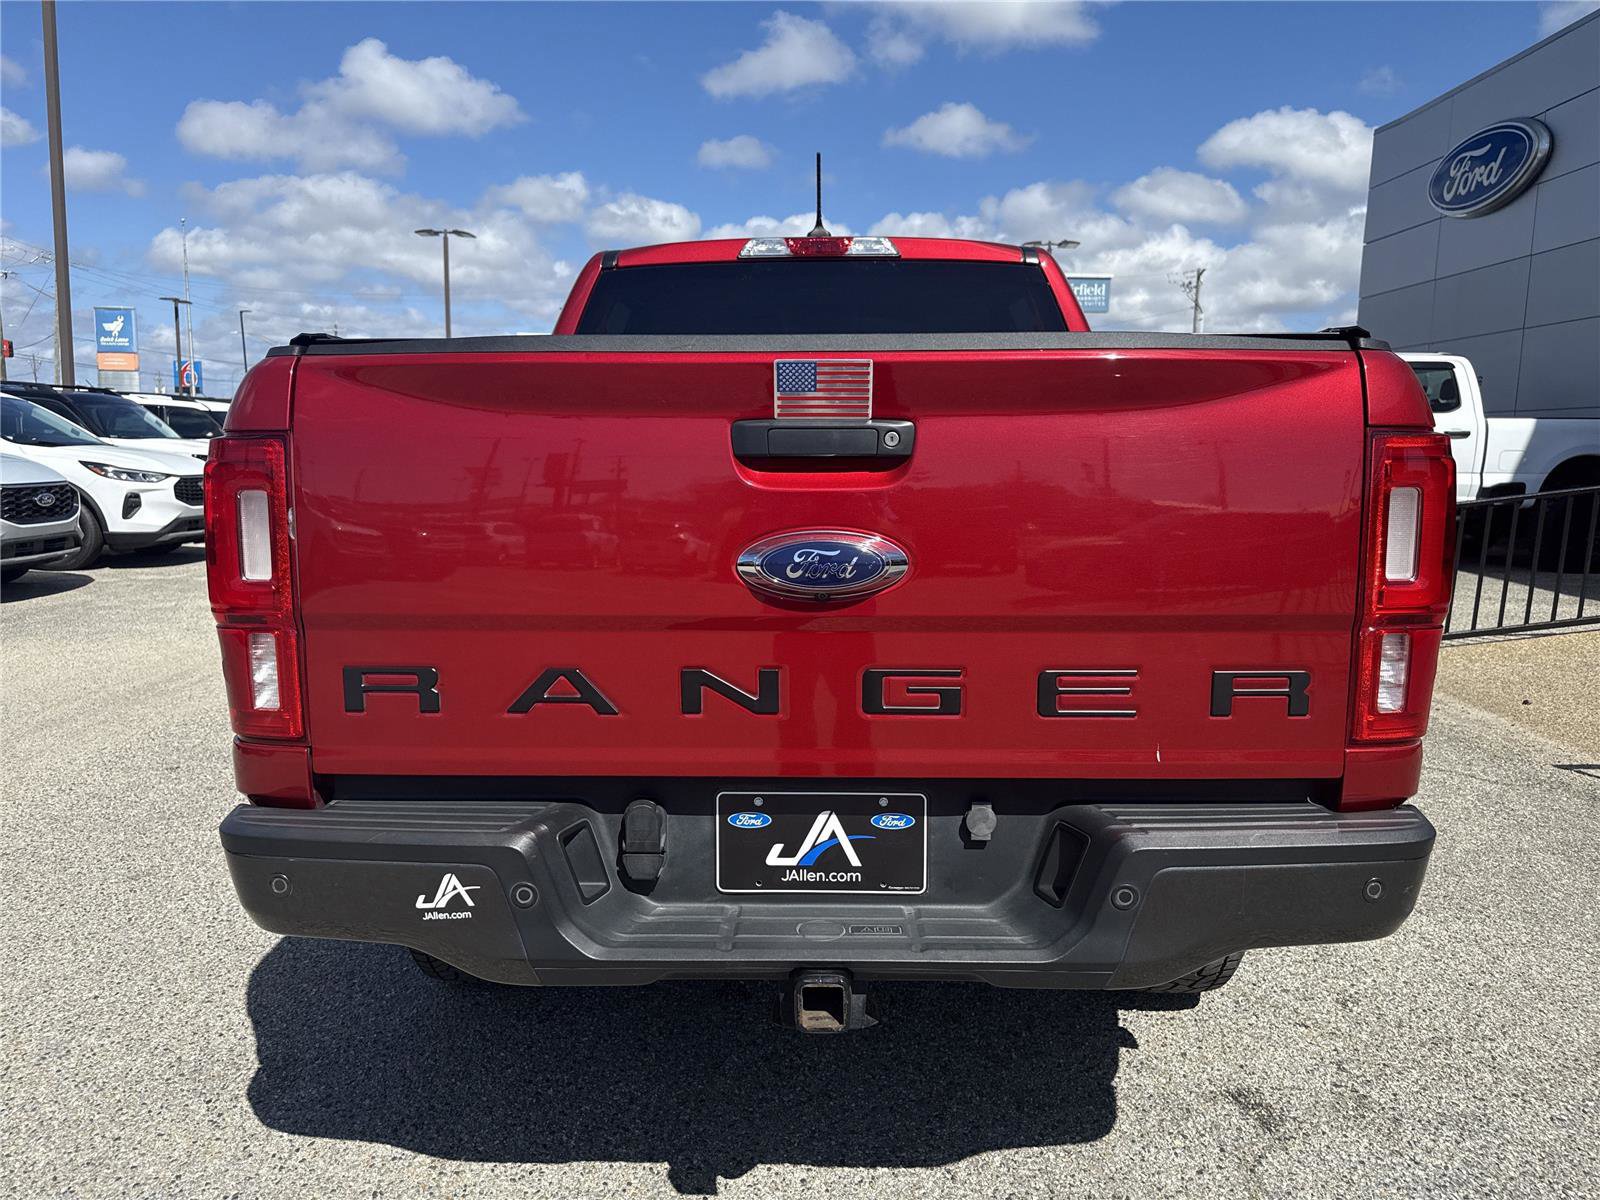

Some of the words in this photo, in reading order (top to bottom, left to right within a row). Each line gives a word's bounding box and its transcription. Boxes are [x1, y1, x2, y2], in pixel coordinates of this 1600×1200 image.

[1443, 143, 1507, 202] Ford
[786, 548, 857, 579] Ford
[343, 665, 1312, 719] RANGER
[736, 813, 763, 826] Ford
[879, 815, 907, 827] Ford
[781, 869, 862, 882] JAllen.com
[422, 911, 473, 921] JAllen.com
